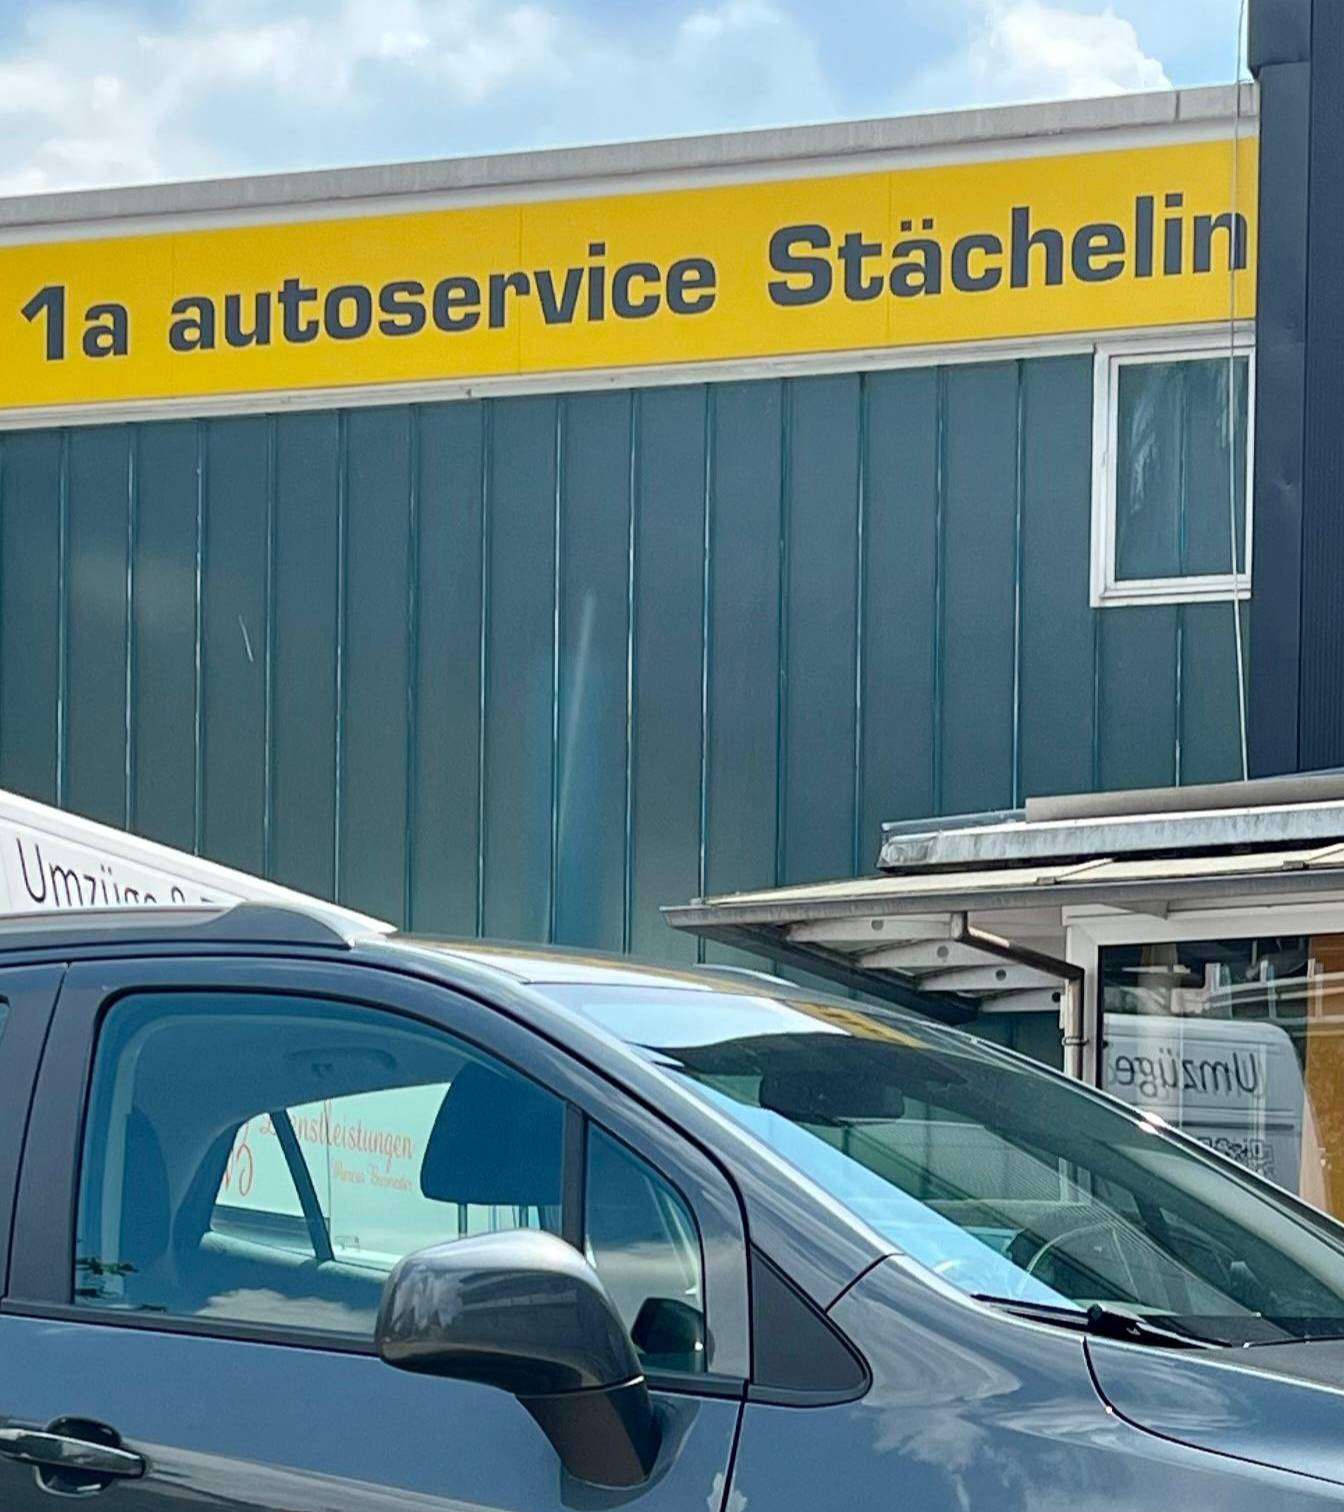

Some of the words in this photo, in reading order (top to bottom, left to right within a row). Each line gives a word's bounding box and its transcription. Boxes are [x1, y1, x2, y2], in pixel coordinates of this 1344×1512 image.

[21, 286, 129, 362] 1a
[168, 241, 717, 352] autoservice
[767, 192, 1249, 307] Stächelin
